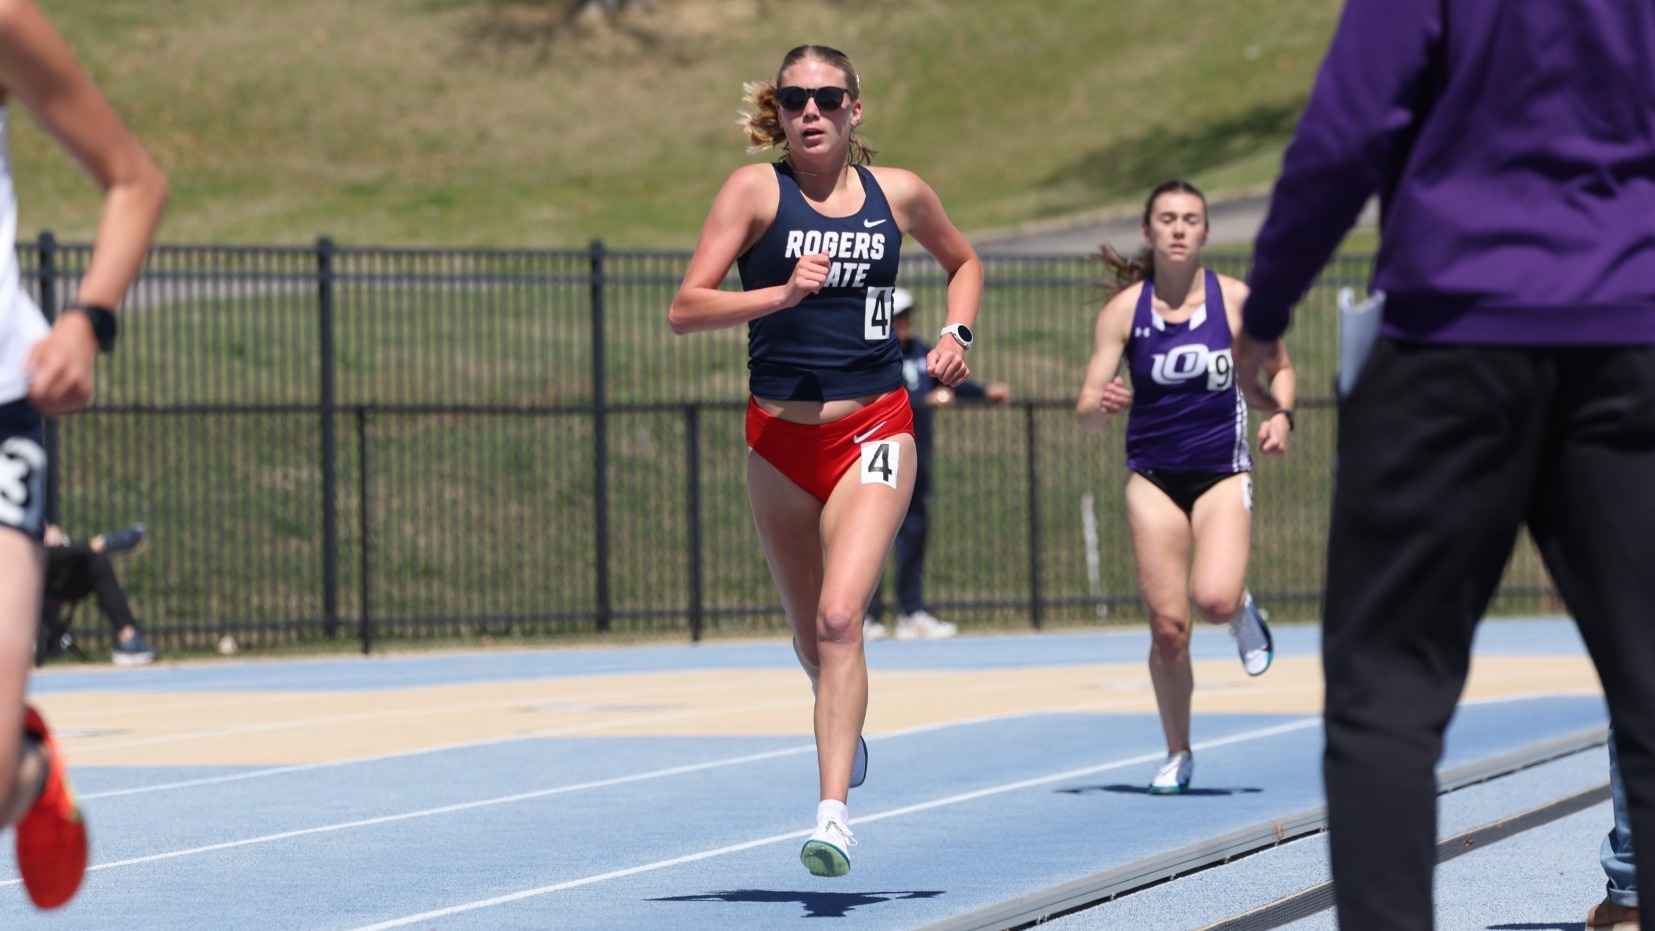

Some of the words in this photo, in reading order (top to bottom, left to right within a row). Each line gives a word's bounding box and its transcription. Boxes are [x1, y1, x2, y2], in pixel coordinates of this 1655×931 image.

[785, 230, 886, 260] ROGERS
[822, 262, 871, 288] ATE
[871, 289, 888, 336] 4
[1215, 354, 1230, 387] 9
[867, 443, 893, 482] 4
